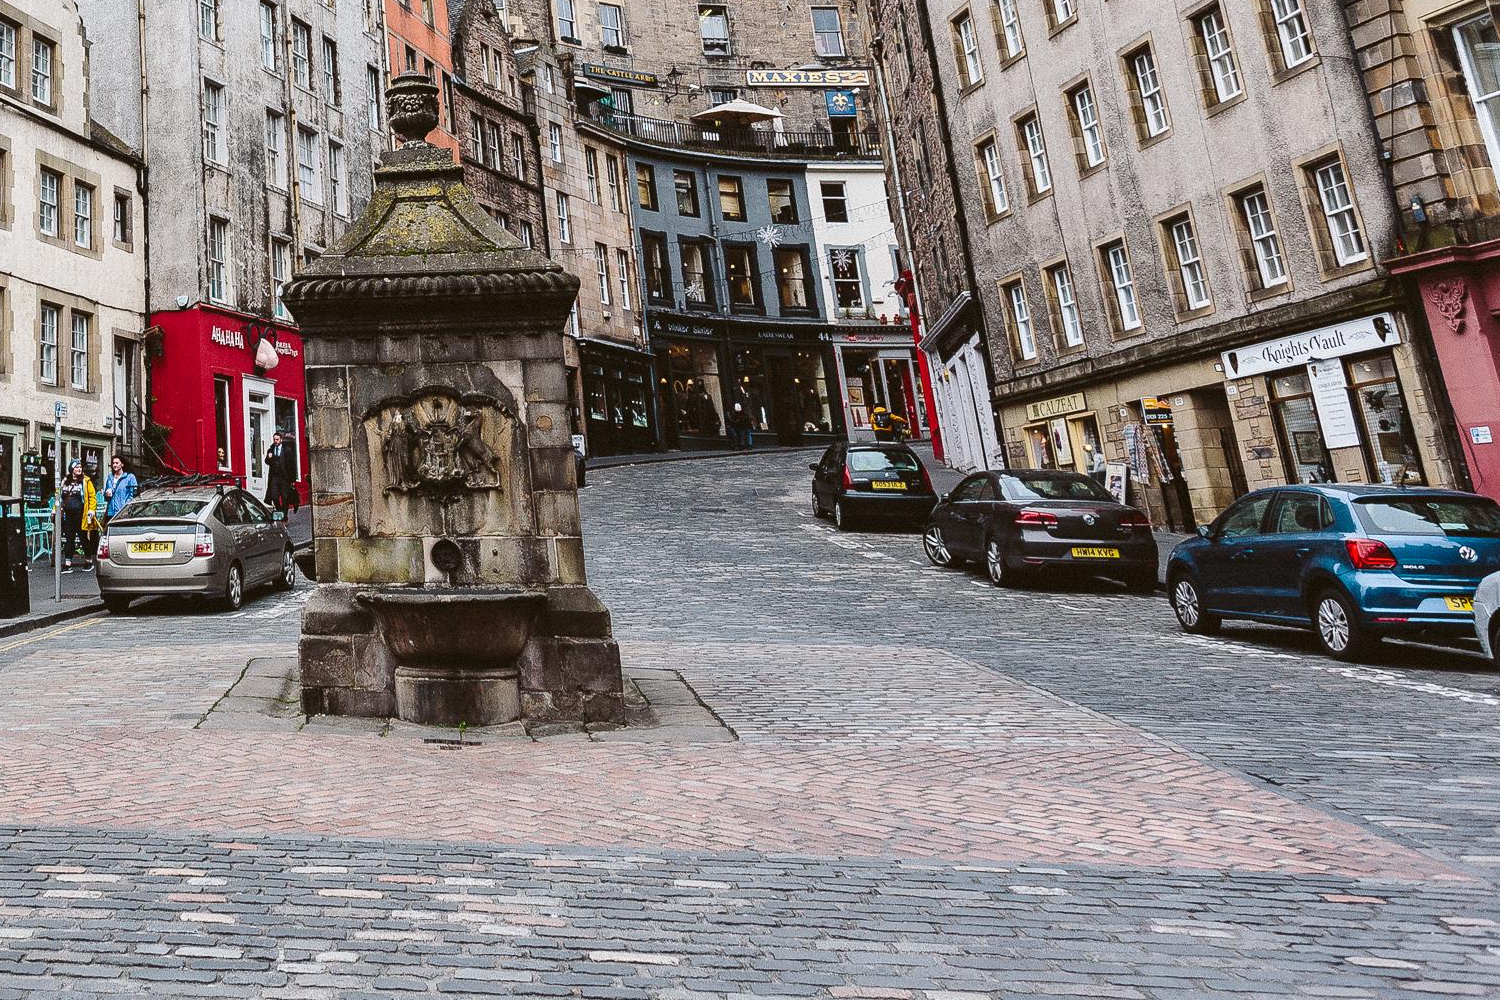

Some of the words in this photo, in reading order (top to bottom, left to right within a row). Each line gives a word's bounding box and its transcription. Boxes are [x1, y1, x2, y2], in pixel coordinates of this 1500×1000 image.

[607, 69, 633, 78] CASTLE
[751, 71, 841, 84] MAXIES
[1262, 339, 1309, 364] Knights
[1309, 329, 1347, 351] Vault
[1039, 396, 1078, 416] CALZEAT
